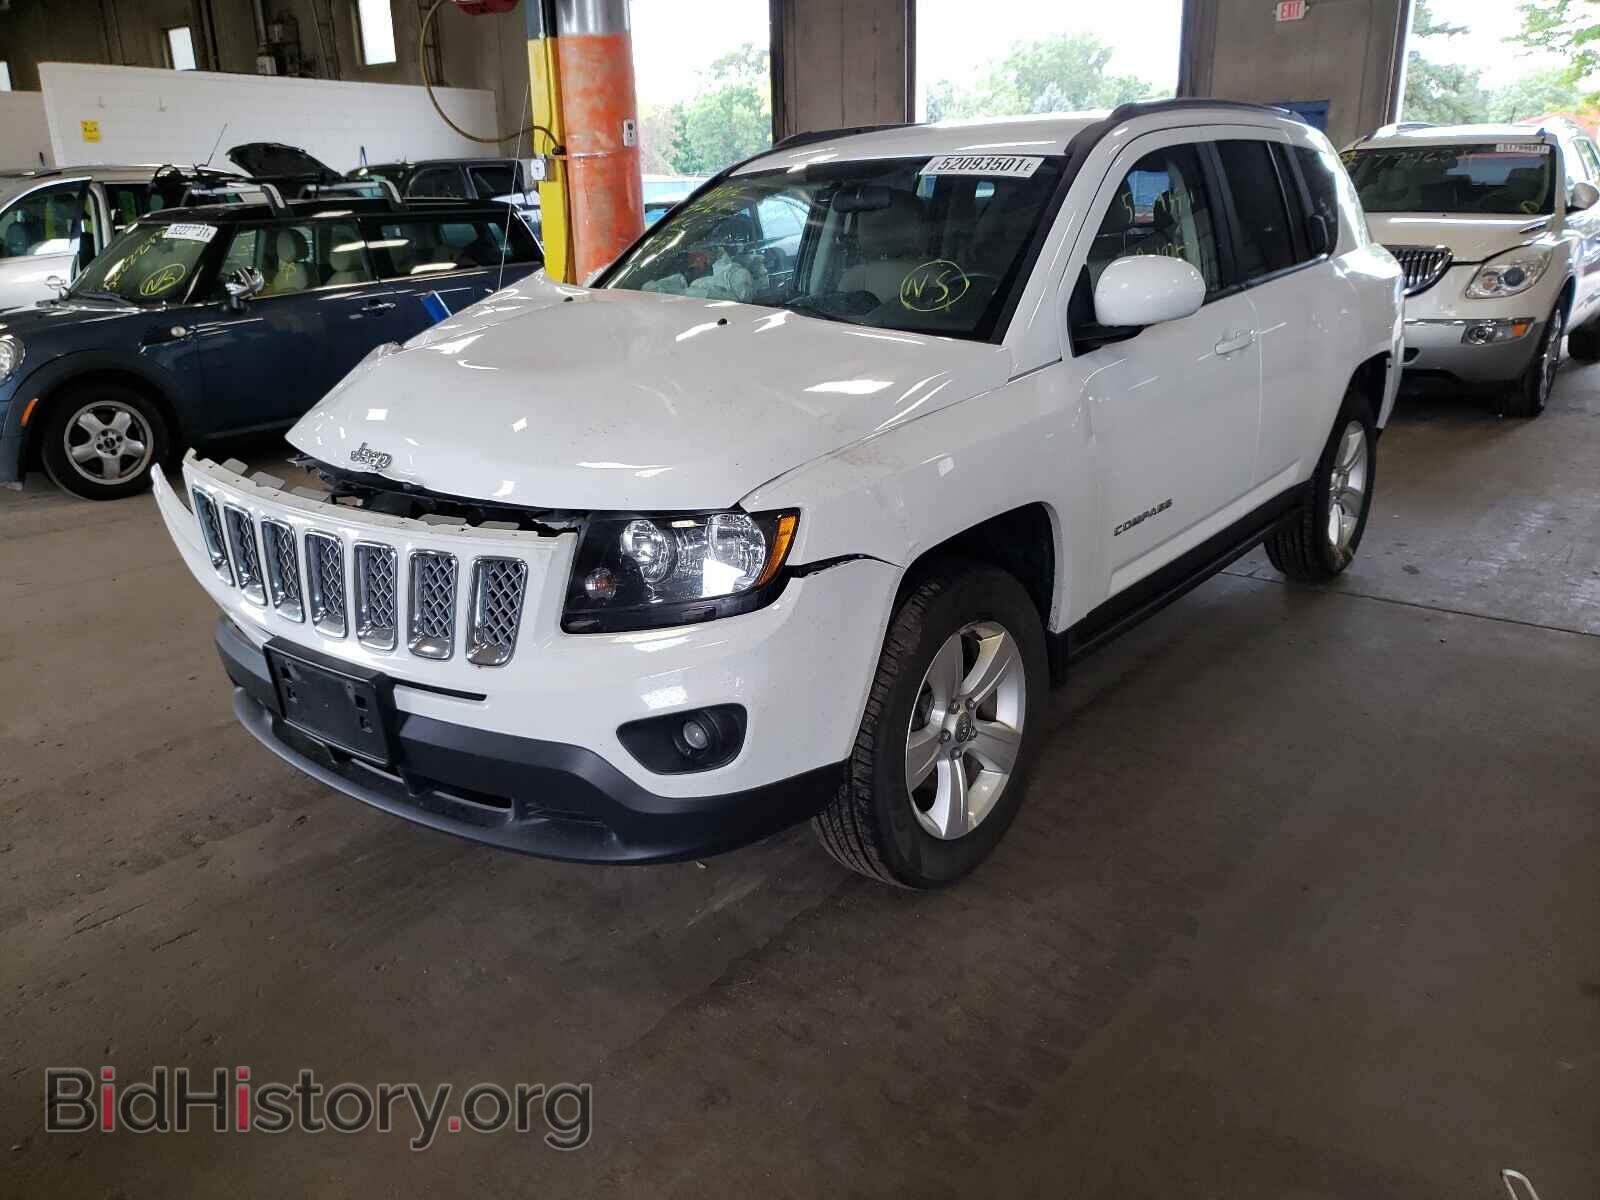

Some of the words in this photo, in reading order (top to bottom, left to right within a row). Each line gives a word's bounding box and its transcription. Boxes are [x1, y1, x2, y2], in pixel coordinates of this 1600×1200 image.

[1280, 2, 1300, 18] EXIT
[937, 157, 1026, 172] 52093501
[1113, 498, 1173, 537] COMPASS
